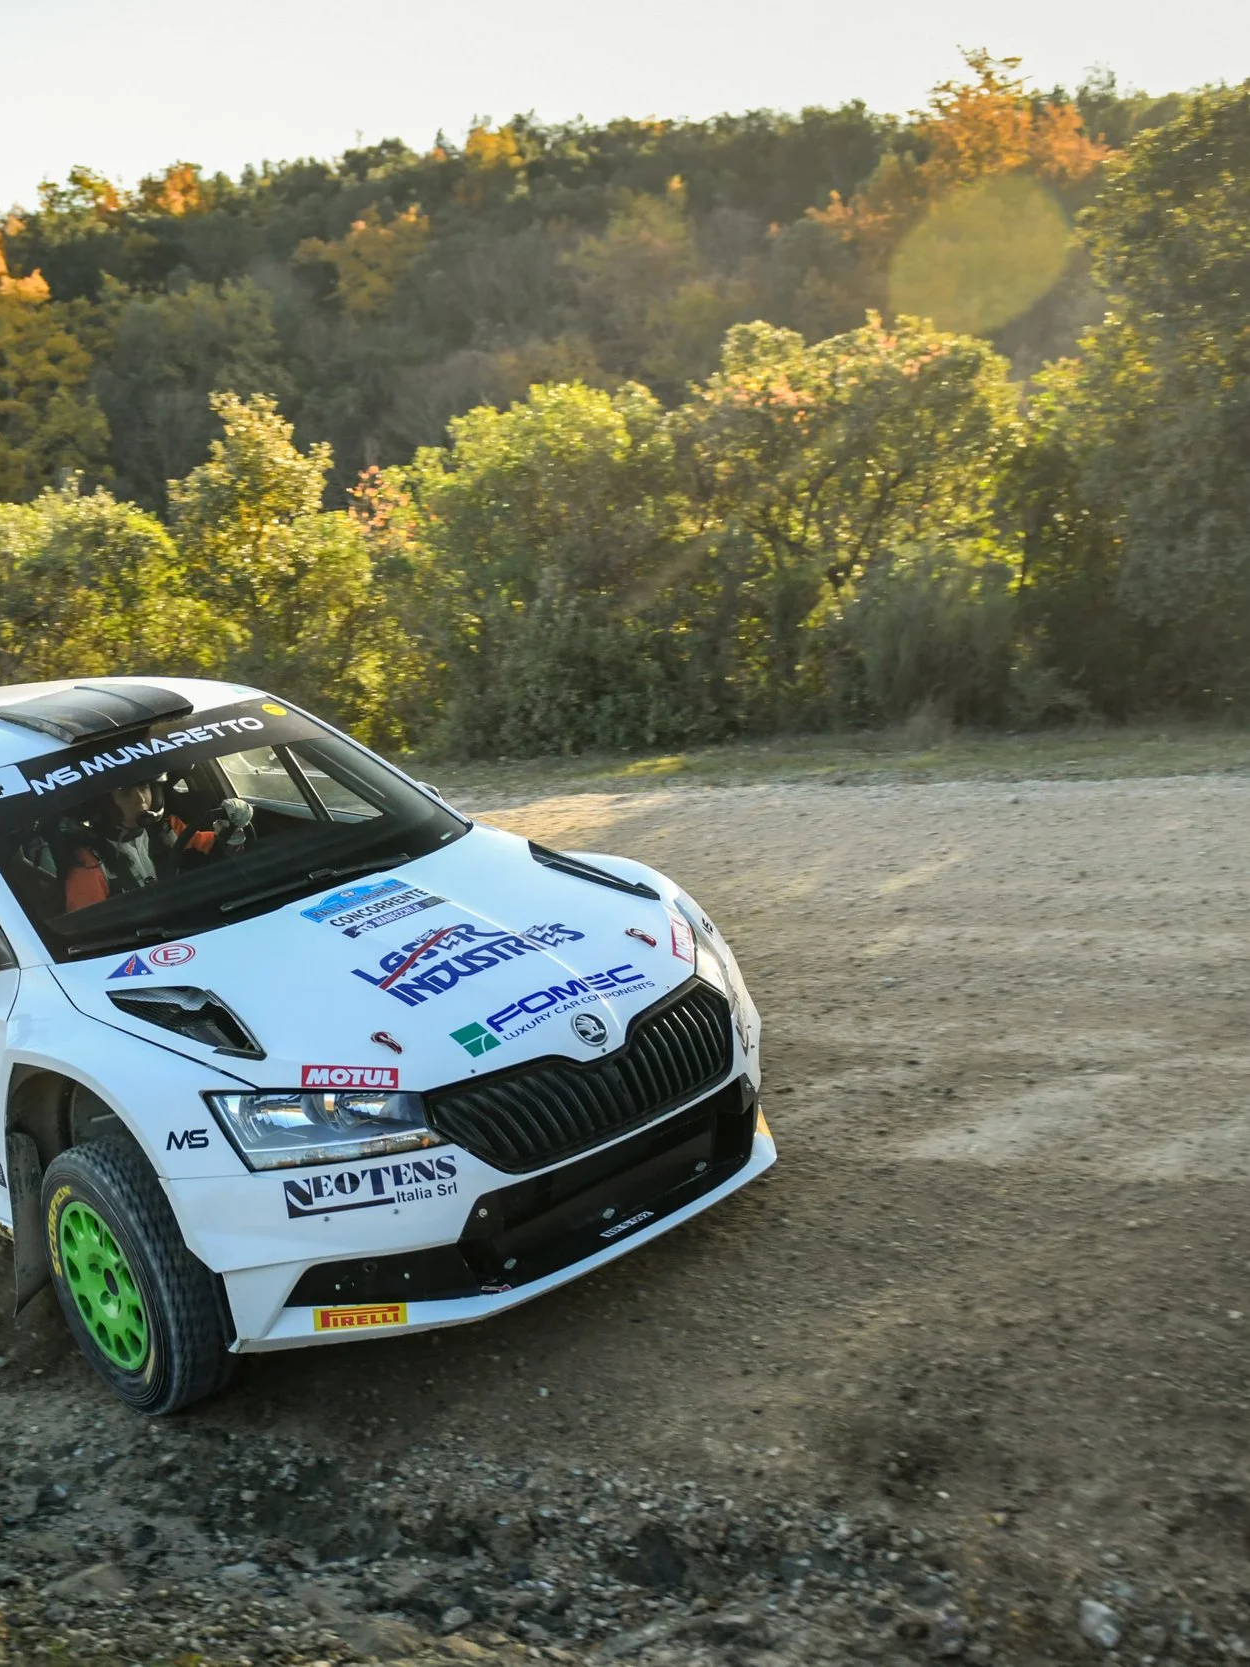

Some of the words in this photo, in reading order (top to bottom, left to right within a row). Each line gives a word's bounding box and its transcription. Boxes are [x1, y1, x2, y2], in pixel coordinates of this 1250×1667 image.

[29, 765, 82, 795] MS
[79, 716, 264, 776] MUNARETTO
[330, 888, 429, 927] CONCORRENTE
[350, 923, 515, 987] LASER
[386, 922, 586, 1007] INDUSTRIES
[486, 964, 645, 1033] FOMEC
[503, 1012, 553, 1041] LUXURY
[554, 1000, 580, 1014] CAR
[581, 980, 656, 1004] COMPONENTS
[305, 1067, 394, 1086] MOTUL
[166, 1129, 209, 1150] MS
[283, 1155, 457, 1219] NEOTENS
[396, 1184, 433, 1203] Italia
[437, 1182, 458, 1197] Srl
[48, 1185, 72, 1278] SCORPION
[320, 1306, 400, 1328] PIRELLI
